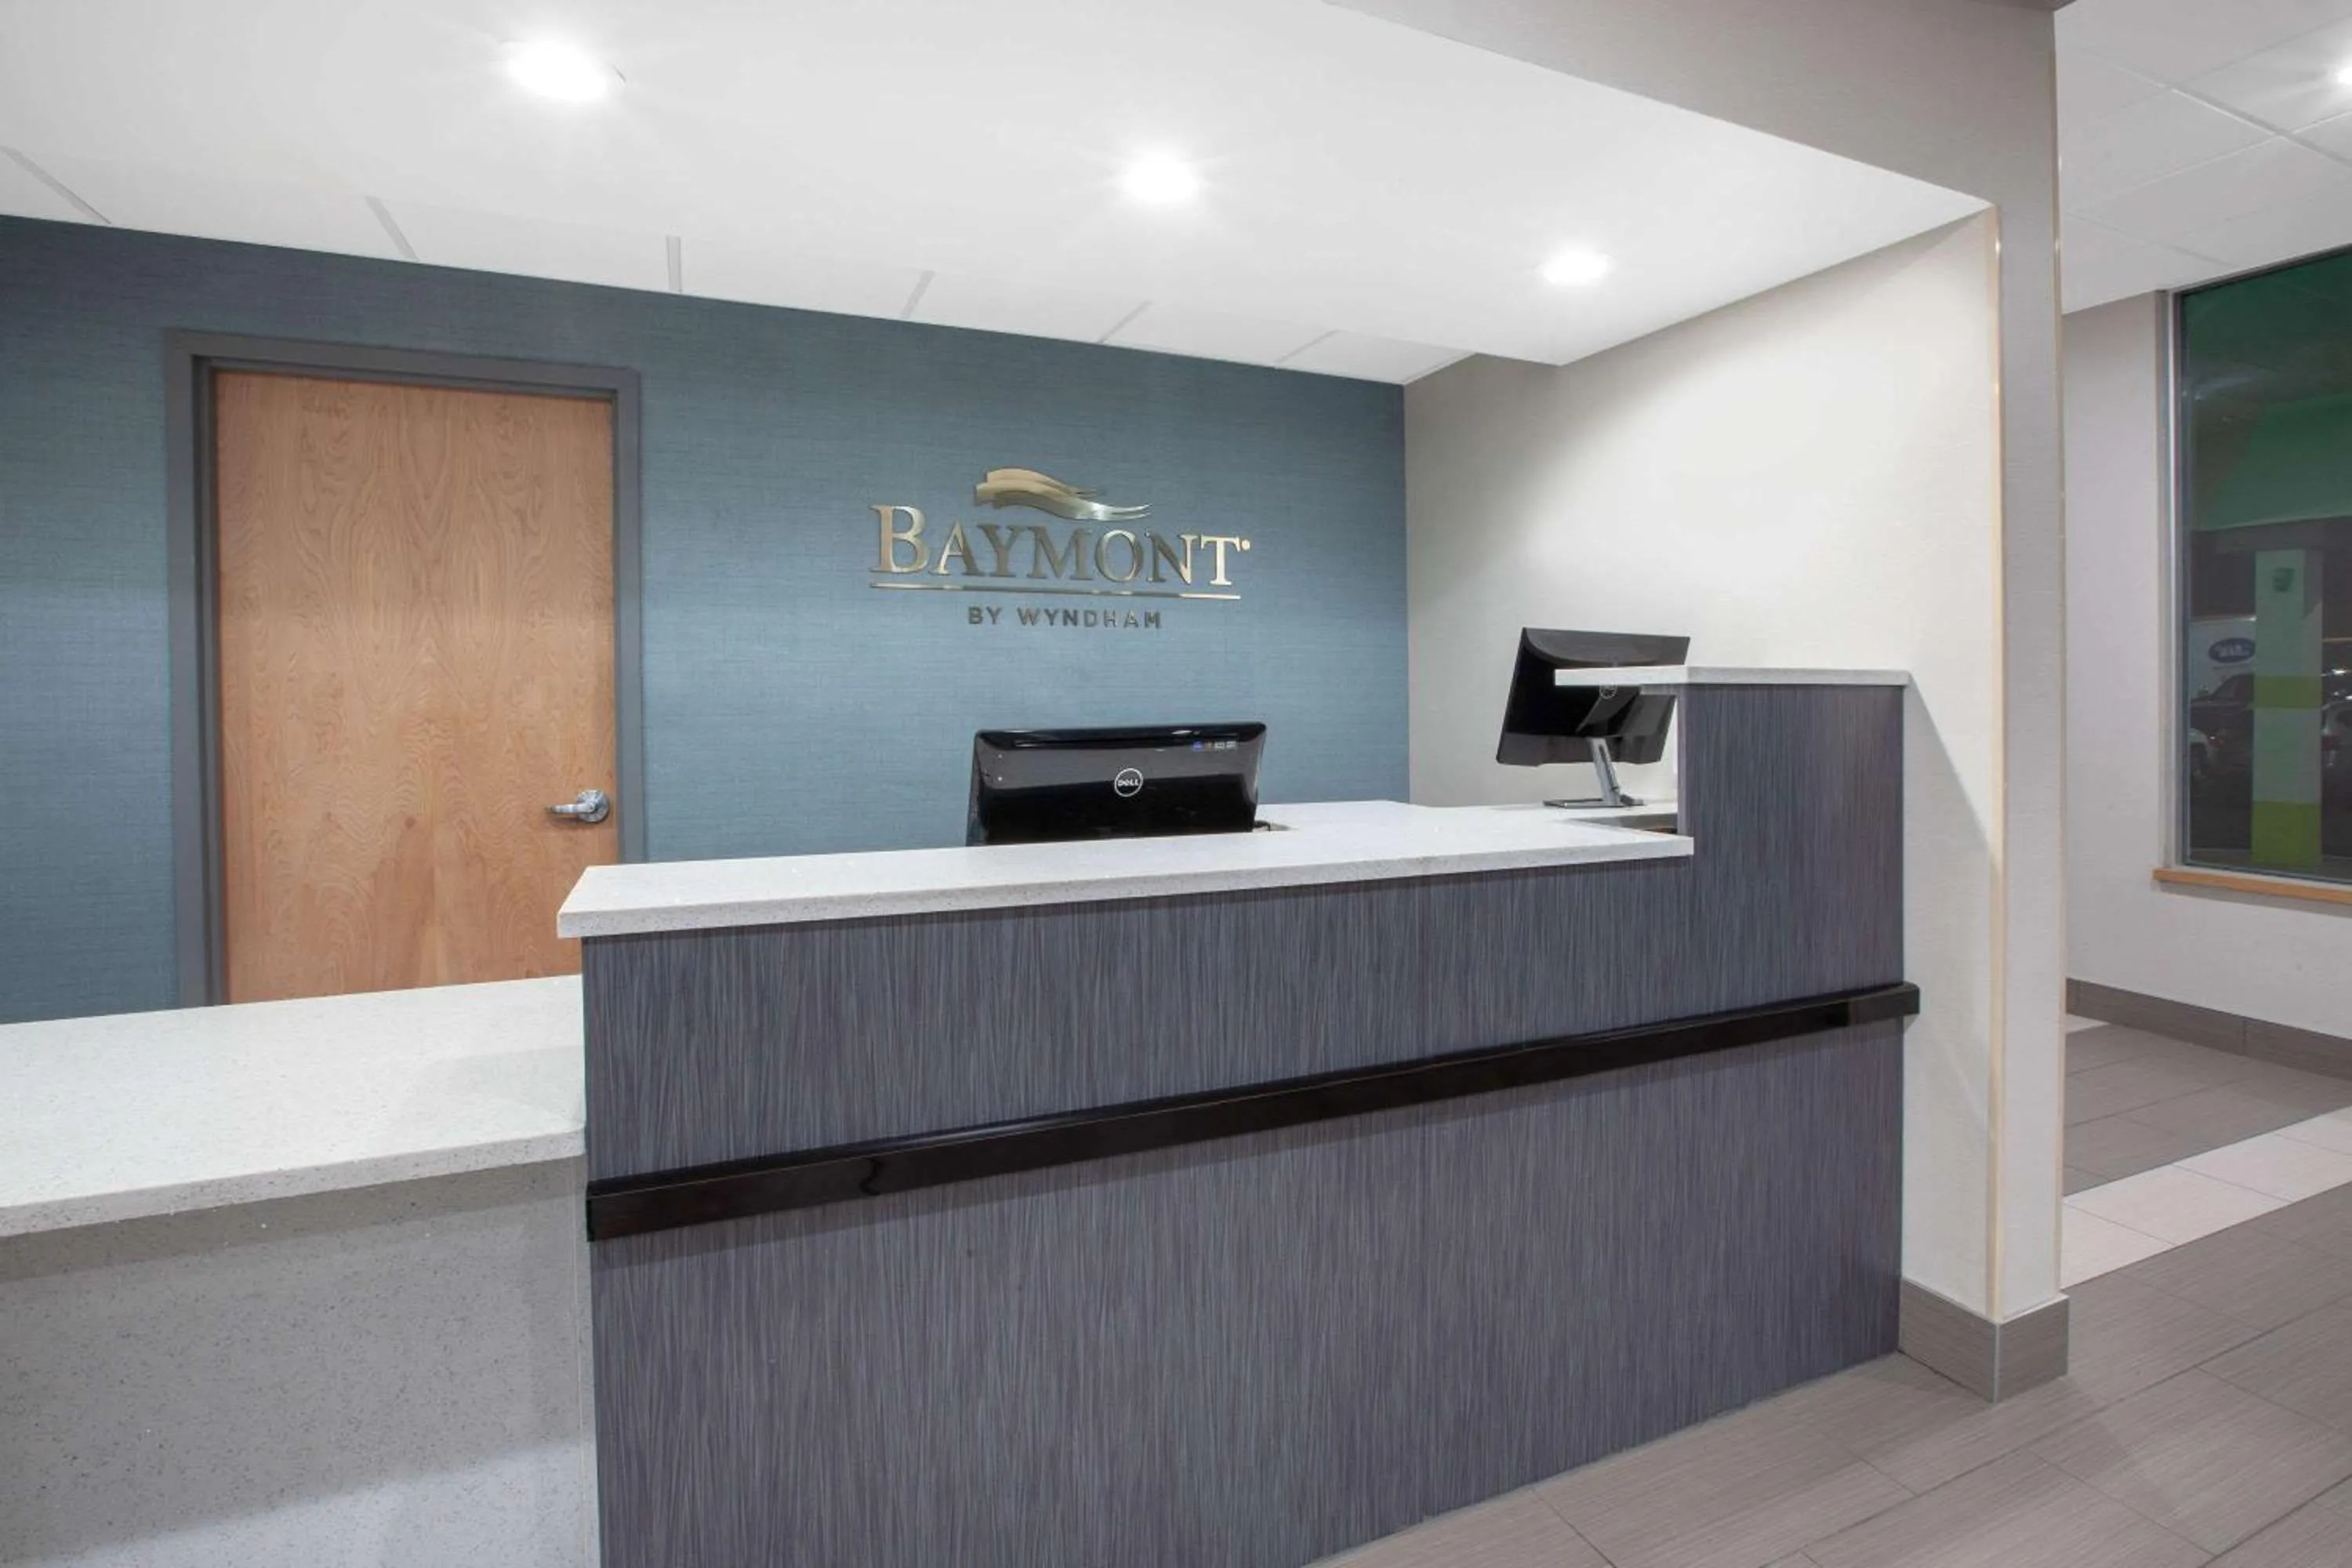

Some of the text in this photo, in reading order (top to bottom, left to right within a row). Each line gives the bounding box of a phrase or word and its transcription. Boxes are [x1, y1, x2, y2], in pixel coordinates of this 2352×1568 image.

[870, 505, 1240, 586] BAYMONT
[968, 607, 1161, 628] BY WYNDHAM
[1117, 779, 1139, 787] DELL
